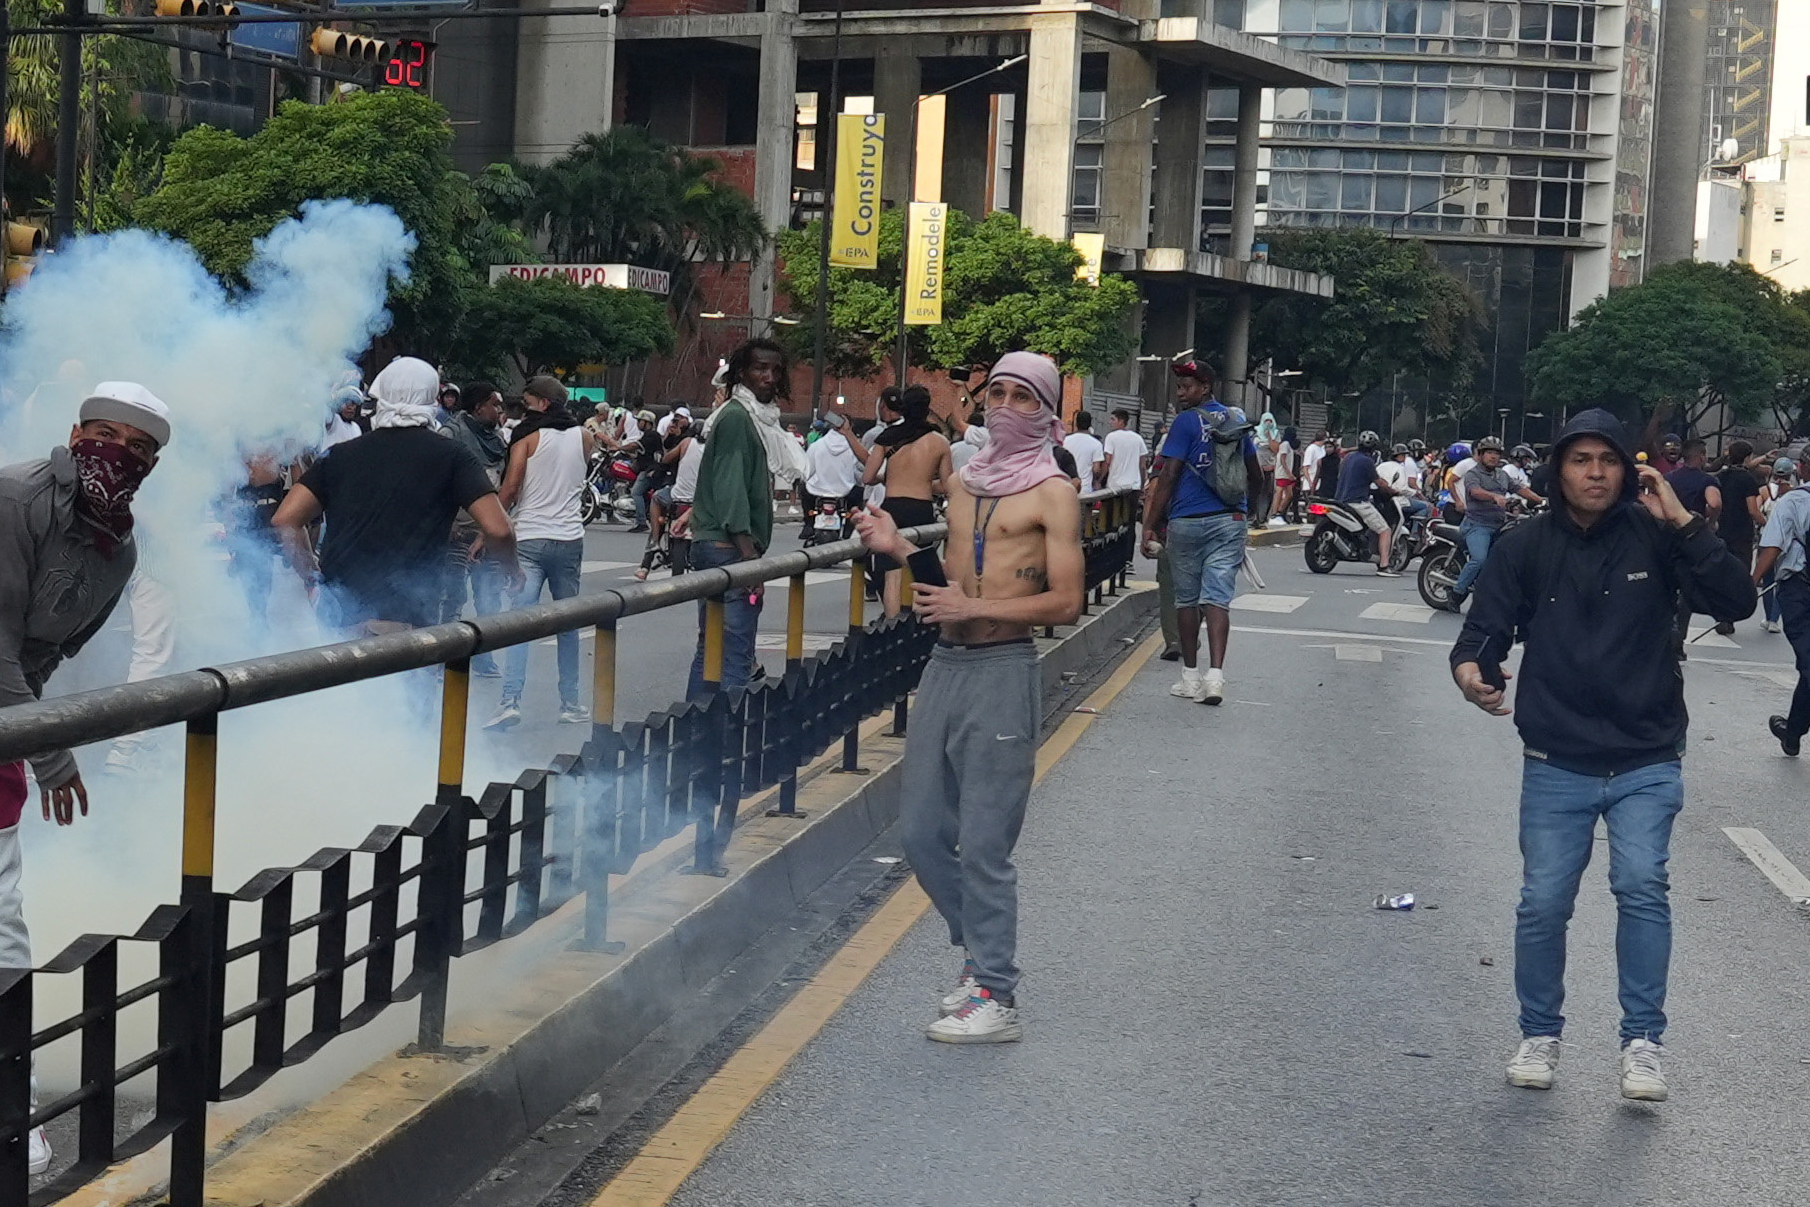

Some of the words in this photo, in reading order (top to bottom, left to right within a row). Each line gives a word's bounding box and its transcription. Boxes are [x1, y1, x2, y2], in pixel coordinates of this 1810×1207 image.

[846, 247, 870, 258] EPA
[920, 207, 940, 300] Remodele
[628, 268, 668, 292] EDICAMPO
[916, 308, 936, 316] EPA
